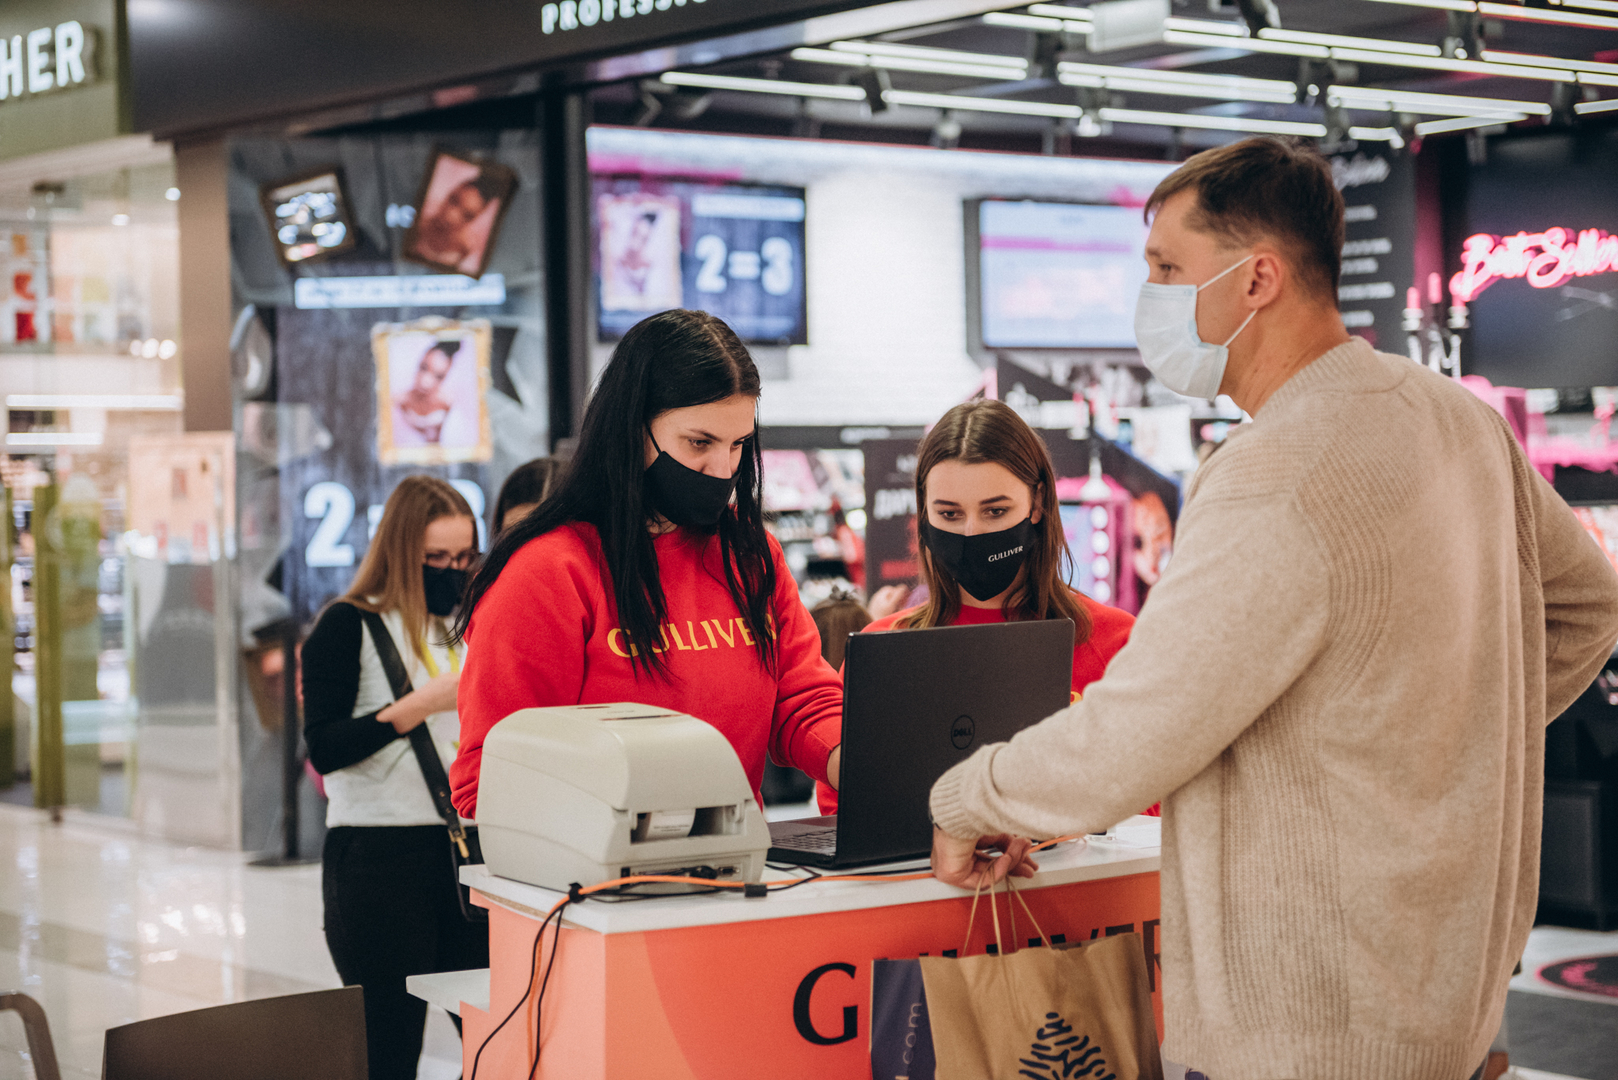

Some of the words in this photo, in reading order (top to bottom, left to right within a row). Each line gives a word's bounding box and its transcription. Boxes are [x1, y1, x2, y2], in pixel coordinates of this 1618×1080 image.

[541, 0, 706, 35] PROFES
[0, 20, 85, 100] HER
[695, 234, 793, 296] 2=3
[988, 545, 1024, 562] GULLIVER
[953, 728, 972, 737] DELL
